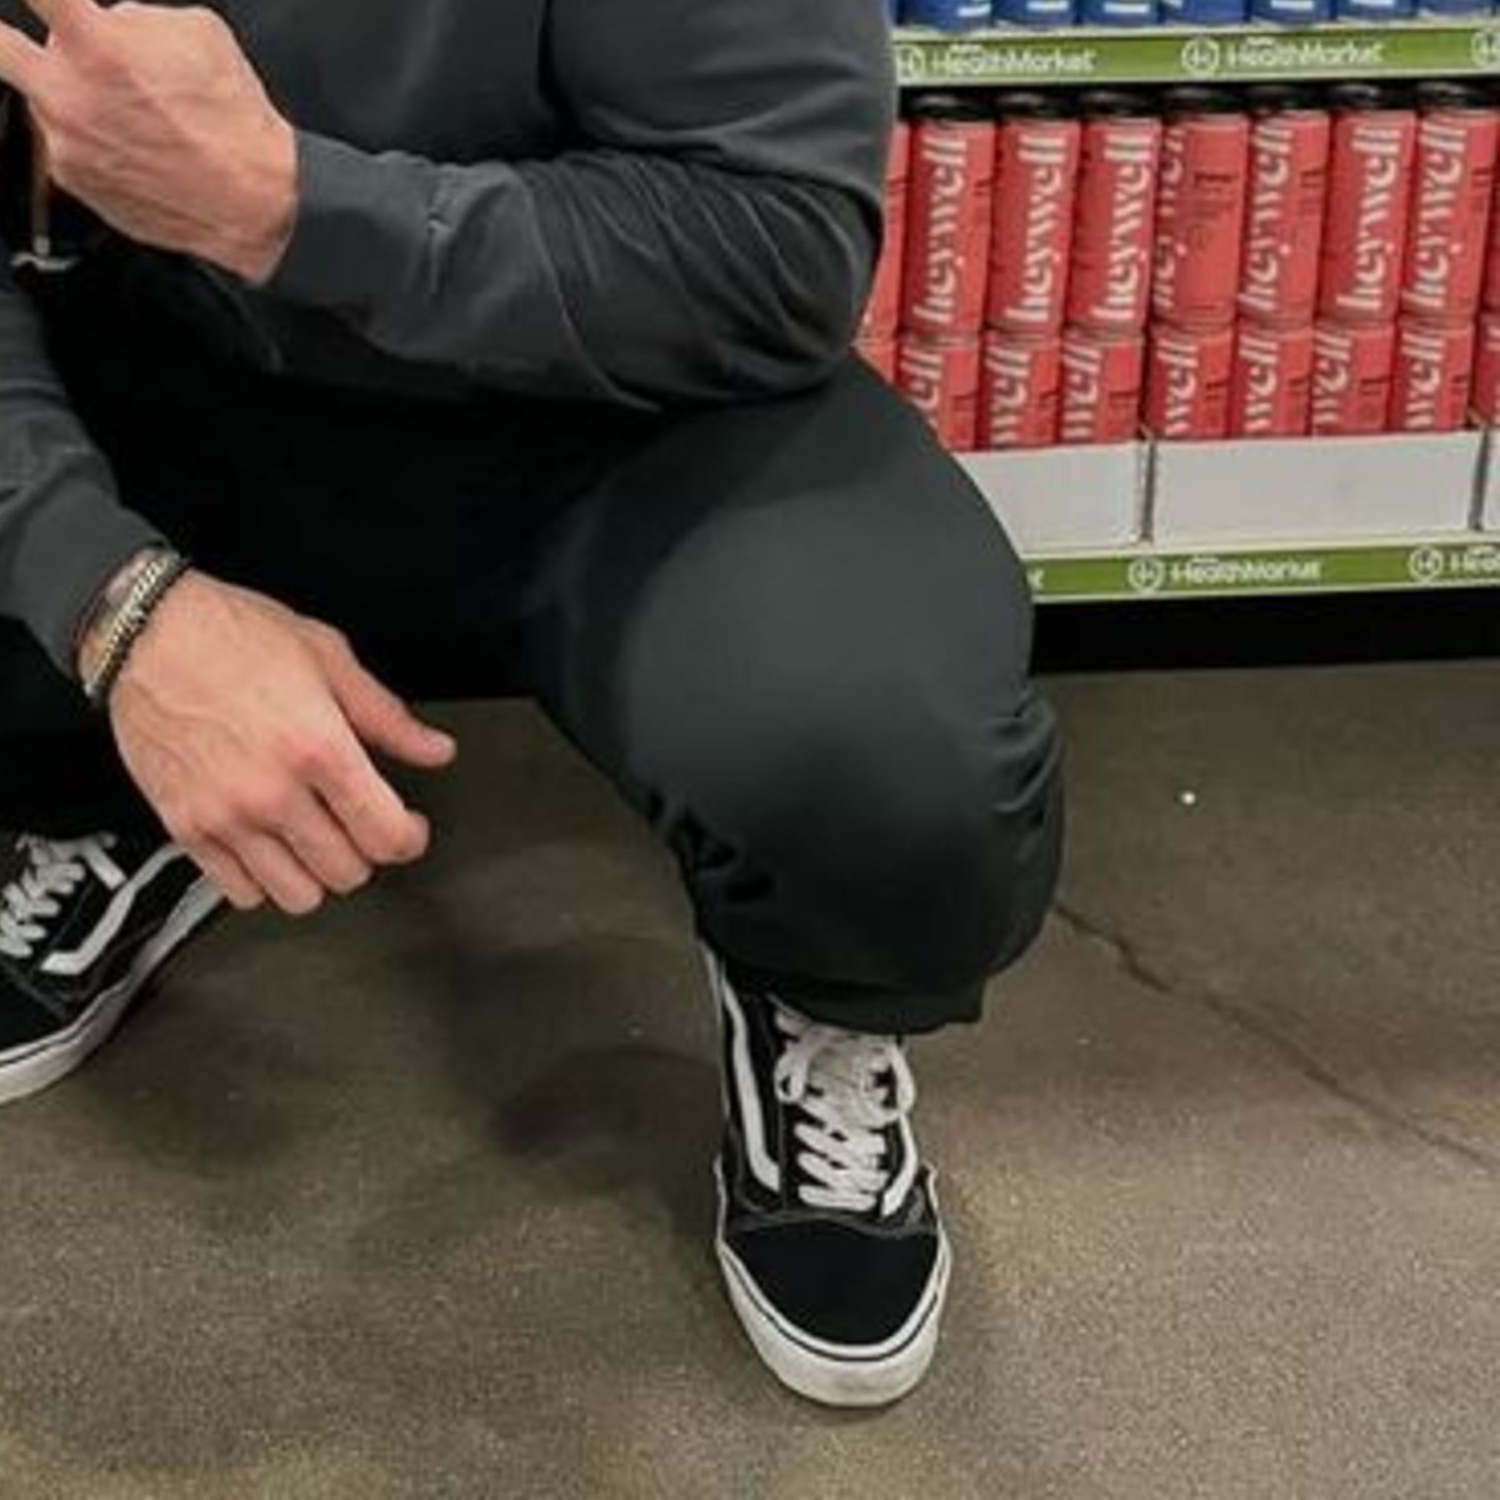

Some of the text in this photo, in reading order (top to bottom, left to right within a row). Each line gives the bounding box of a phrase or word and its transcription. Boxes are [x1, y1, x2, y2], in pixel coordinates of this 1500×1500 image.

[913, 135, 966, 322] heywell
[1006, 133, 1065, 319] heywell
[1090, 133, 1150, 319] heywell
[1239, 124, 1292, 310] heywell
[1337, 126, 1401, 311] heywell
[1402, 120, 1468, 308] heywell
